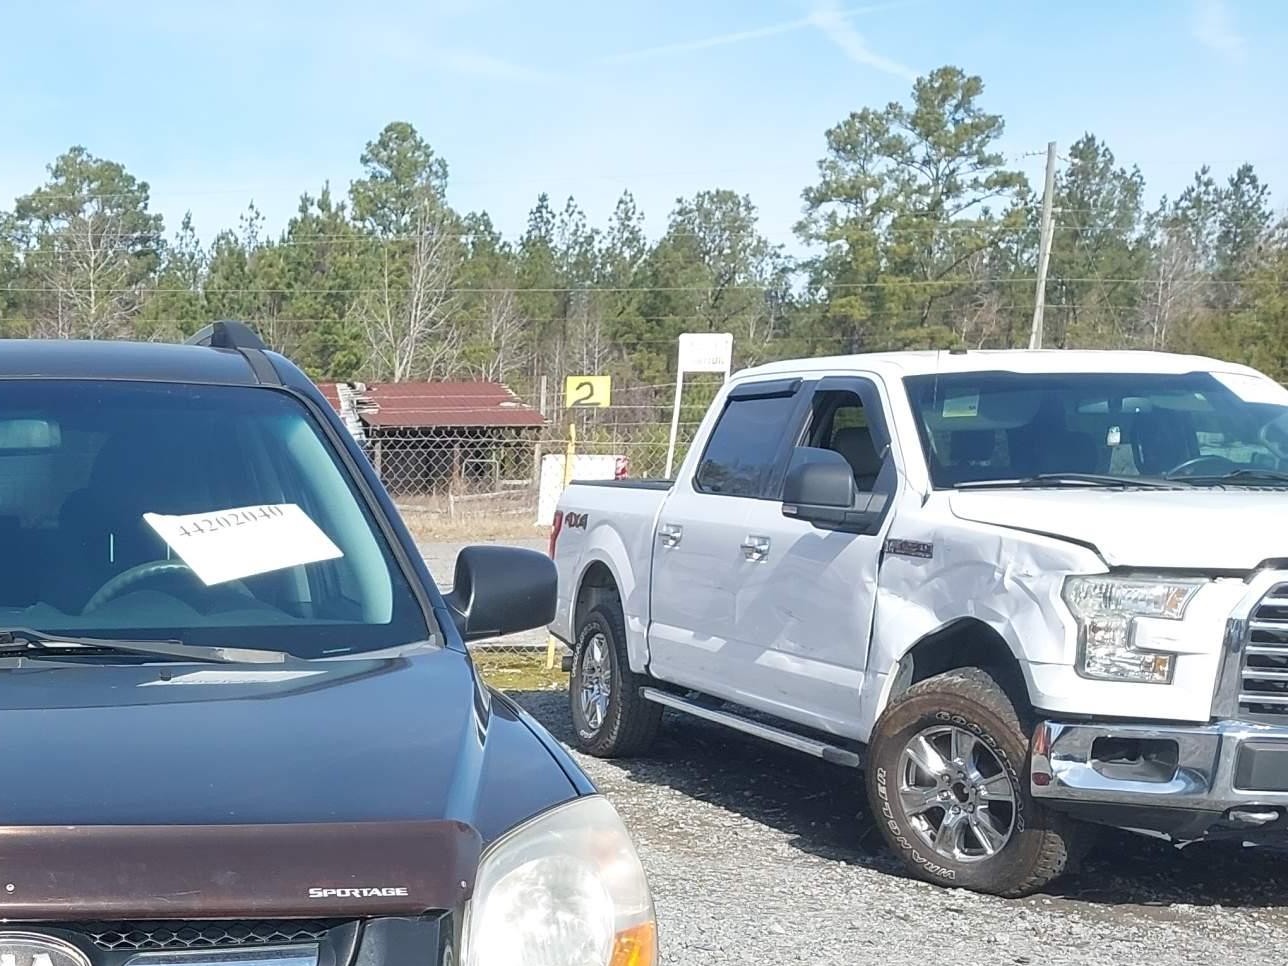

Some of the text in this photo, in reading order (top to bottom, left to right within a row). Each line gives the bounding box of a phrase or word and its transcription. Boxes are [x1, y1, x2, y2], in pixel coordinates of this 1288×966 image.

[571, 381, 601, 407] 2
[178, 505, 284, 537] 44202040
[876, 767, 956, 880] WRANGLER
[308, 887, 409, 898] SPORTAGE
